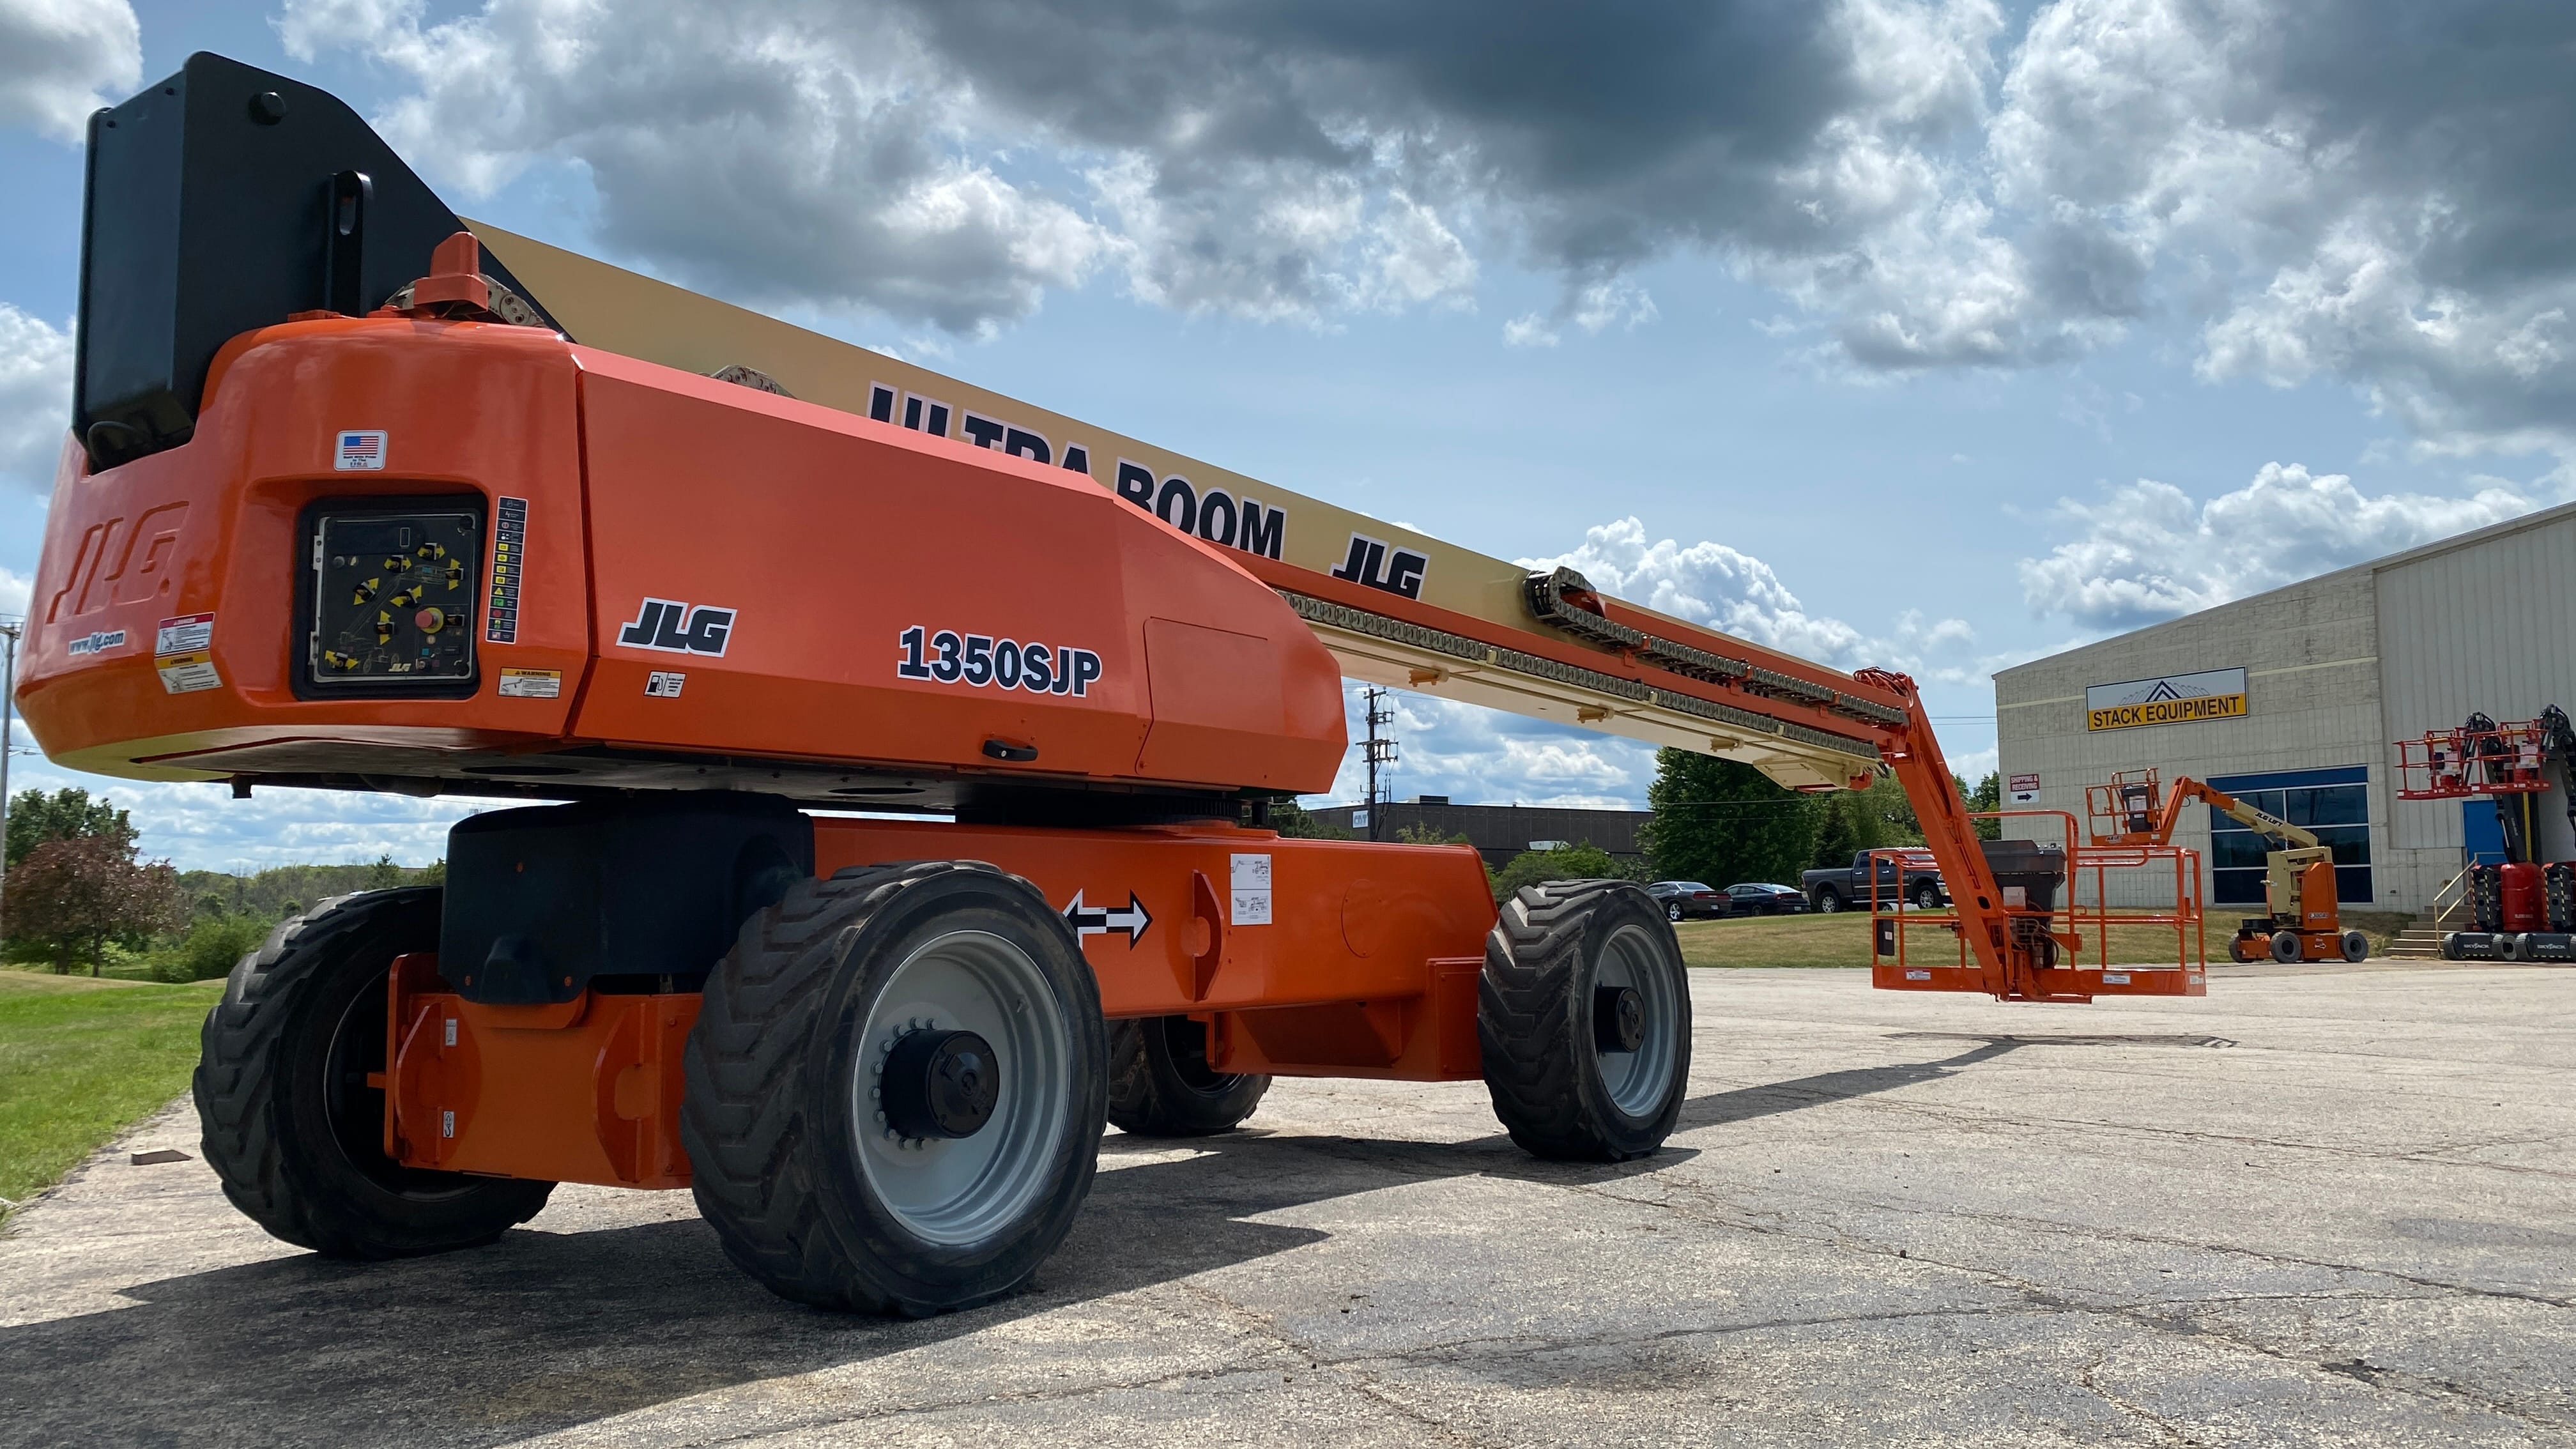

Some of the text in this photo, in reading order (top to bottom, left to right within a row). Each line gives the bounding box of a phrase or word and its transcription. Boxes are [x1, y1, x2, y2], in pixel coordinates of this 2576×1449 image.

[1116, 460, 1285, 561] BOOM
[46, 500, 189, 624] JLG
[1330, 535, 1428, 601] JLG
[620, 600, 733, 654] JLG
[388, 663, 411, 672] JLG
[898, 627, 1101, 696] 1350SJP
[2094, 696, 2239, 727] STACK EQUIPMENT
[2011, 775, 2034, 783] SHIPPING
[2255, 812, 2283, 827] JLG LIFT
